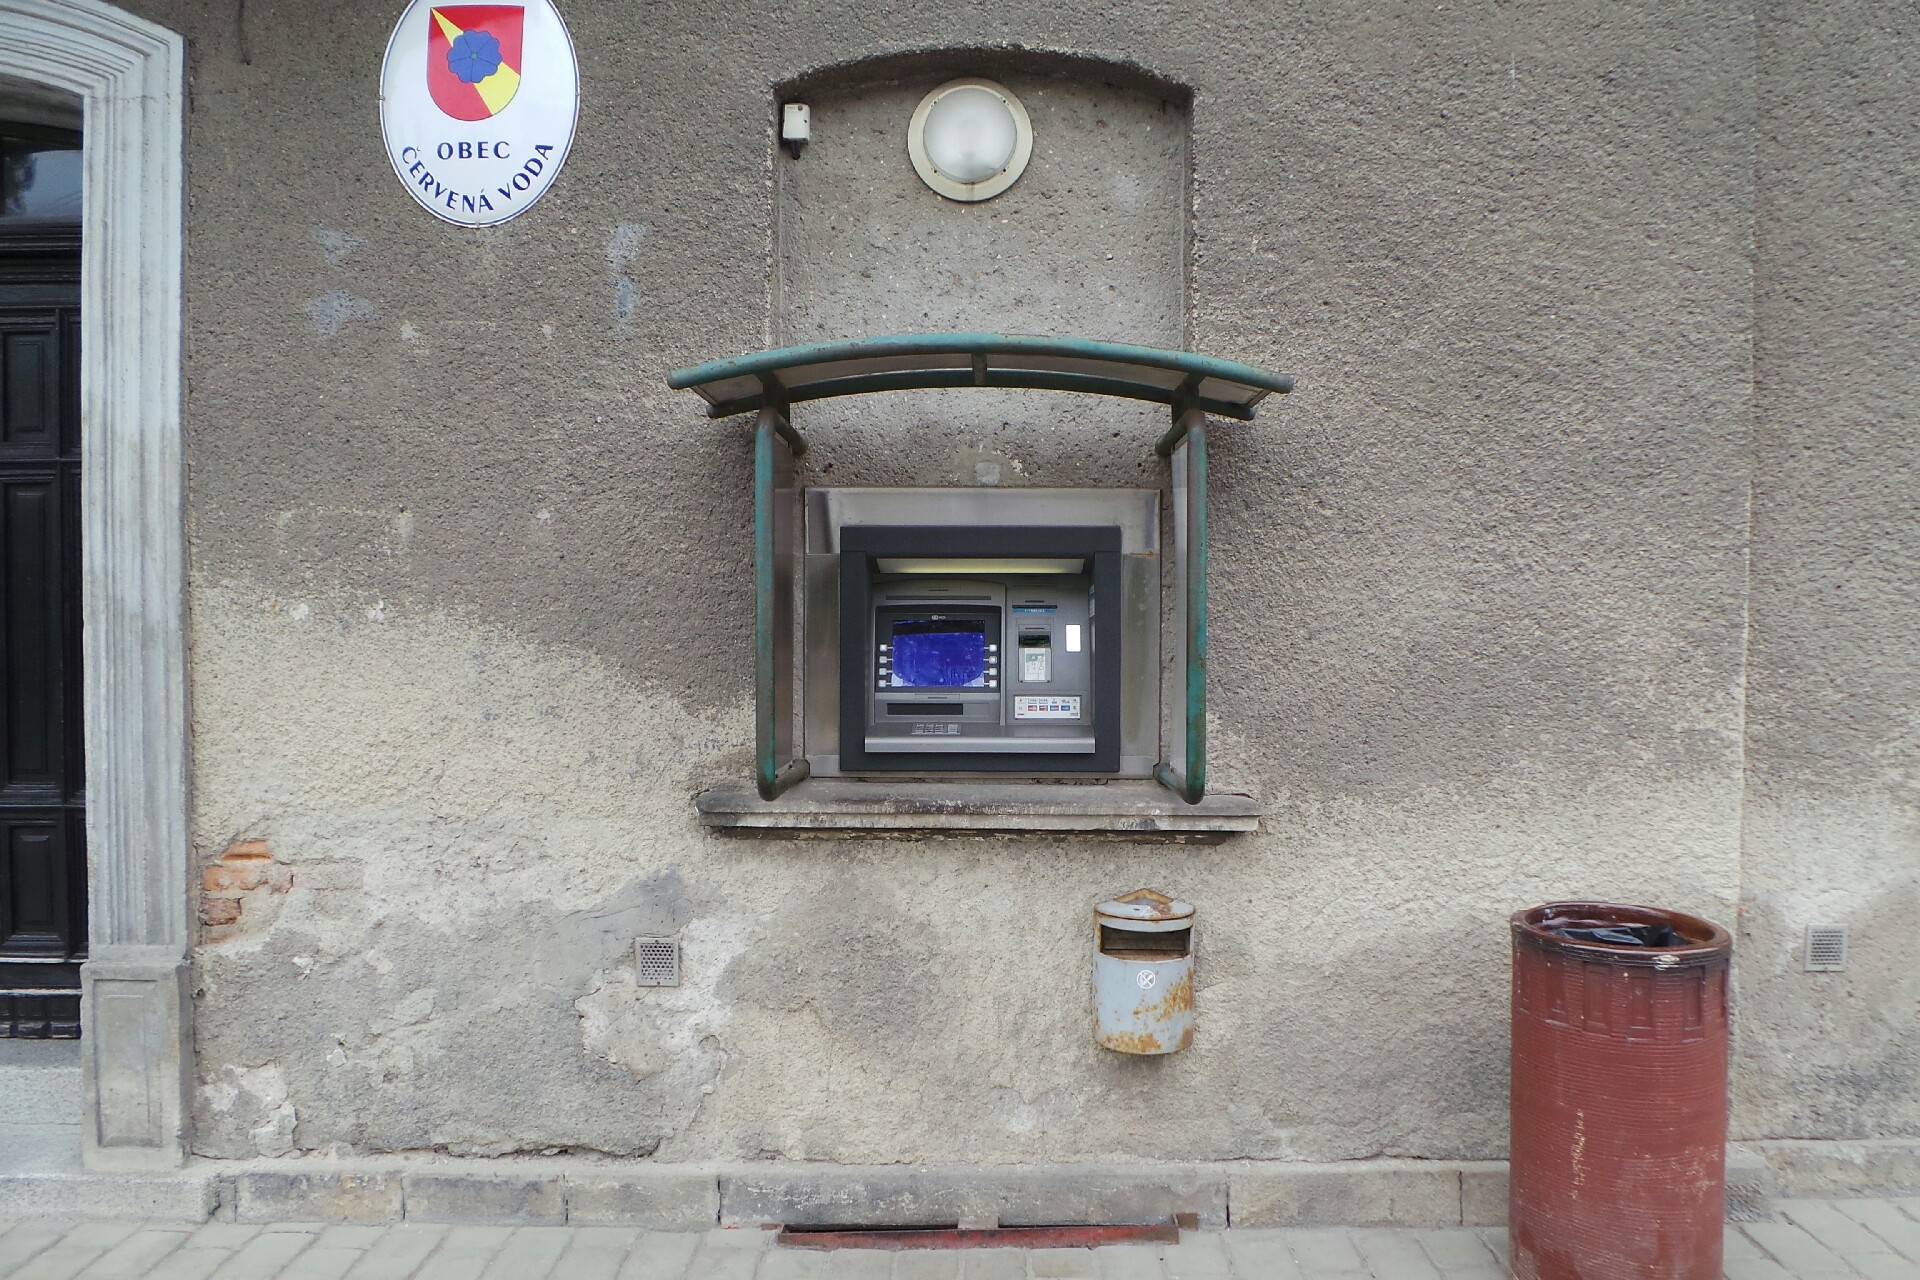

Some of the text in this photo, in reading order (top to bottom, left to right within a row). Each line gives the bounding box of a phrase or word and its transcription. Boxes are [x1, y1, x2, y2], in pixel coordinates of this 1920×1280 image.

[437, 141, 510, 160] OBEC
[402, 144, 554, 213] ČERVENÁ VODA
